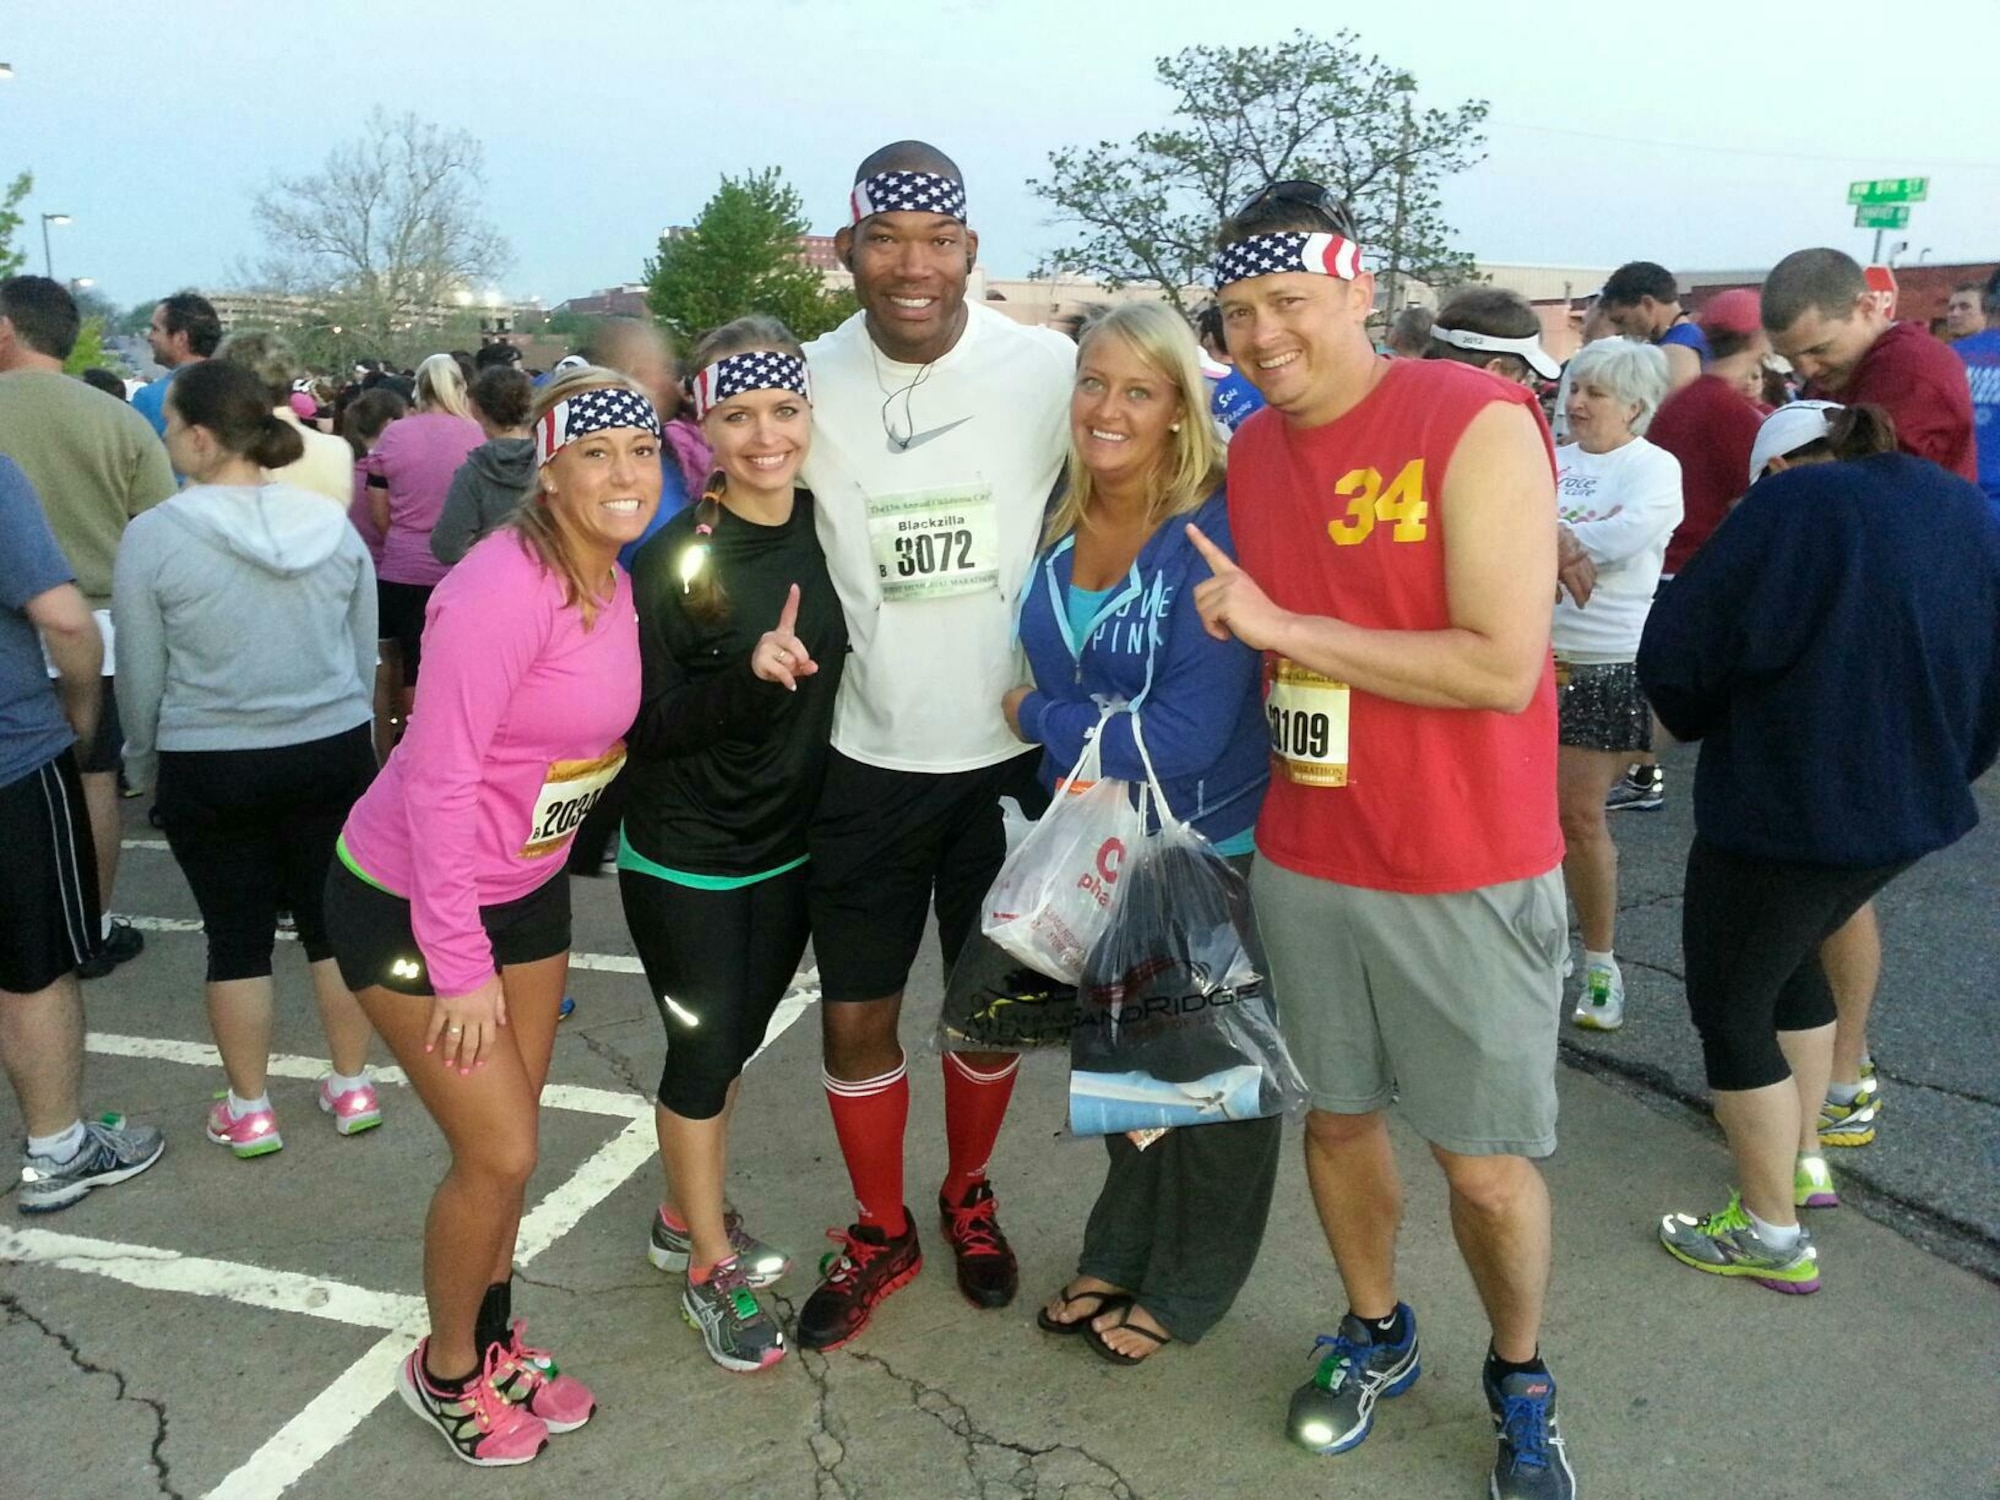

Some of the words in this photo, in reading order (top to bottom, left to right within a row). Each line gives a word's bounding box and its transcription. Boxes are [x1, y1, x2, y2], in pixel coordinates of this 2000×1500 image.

[1328, 458, 1429, 545] 34
[898, 516, 965, 531] Blackzilla
[895, 529, 975, 577] 3072
[879, 564, 887, 578] B
[1092, 621, 1163, 654] PIN
